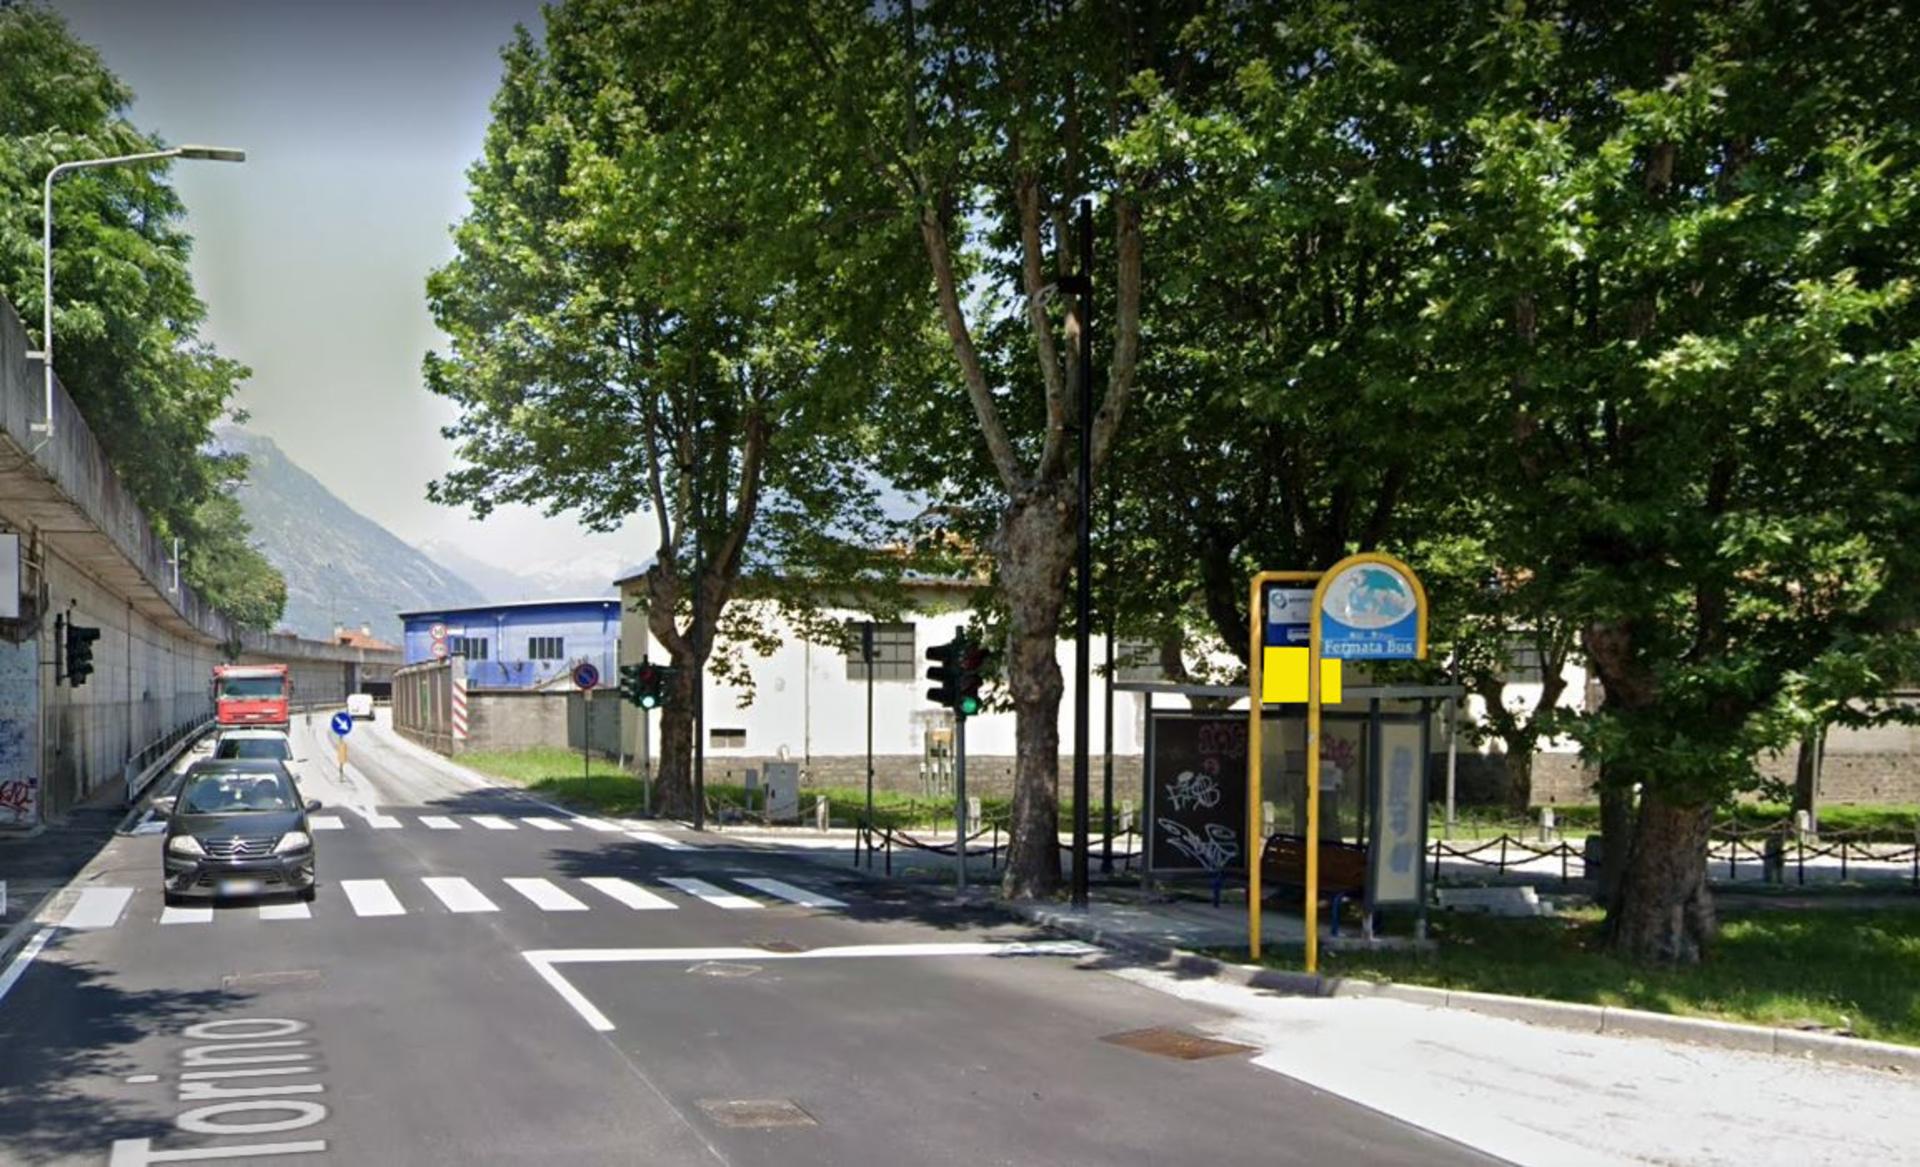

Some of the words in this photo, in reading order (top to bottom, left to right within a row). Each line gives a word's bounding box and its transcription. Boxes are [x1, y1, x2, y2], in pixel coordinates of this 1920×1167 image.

[1324, 640, 1383, 655] Fermata
[1388, 639, 1413, 654] Bus
[110, 1018, 326, 1167] Torino
